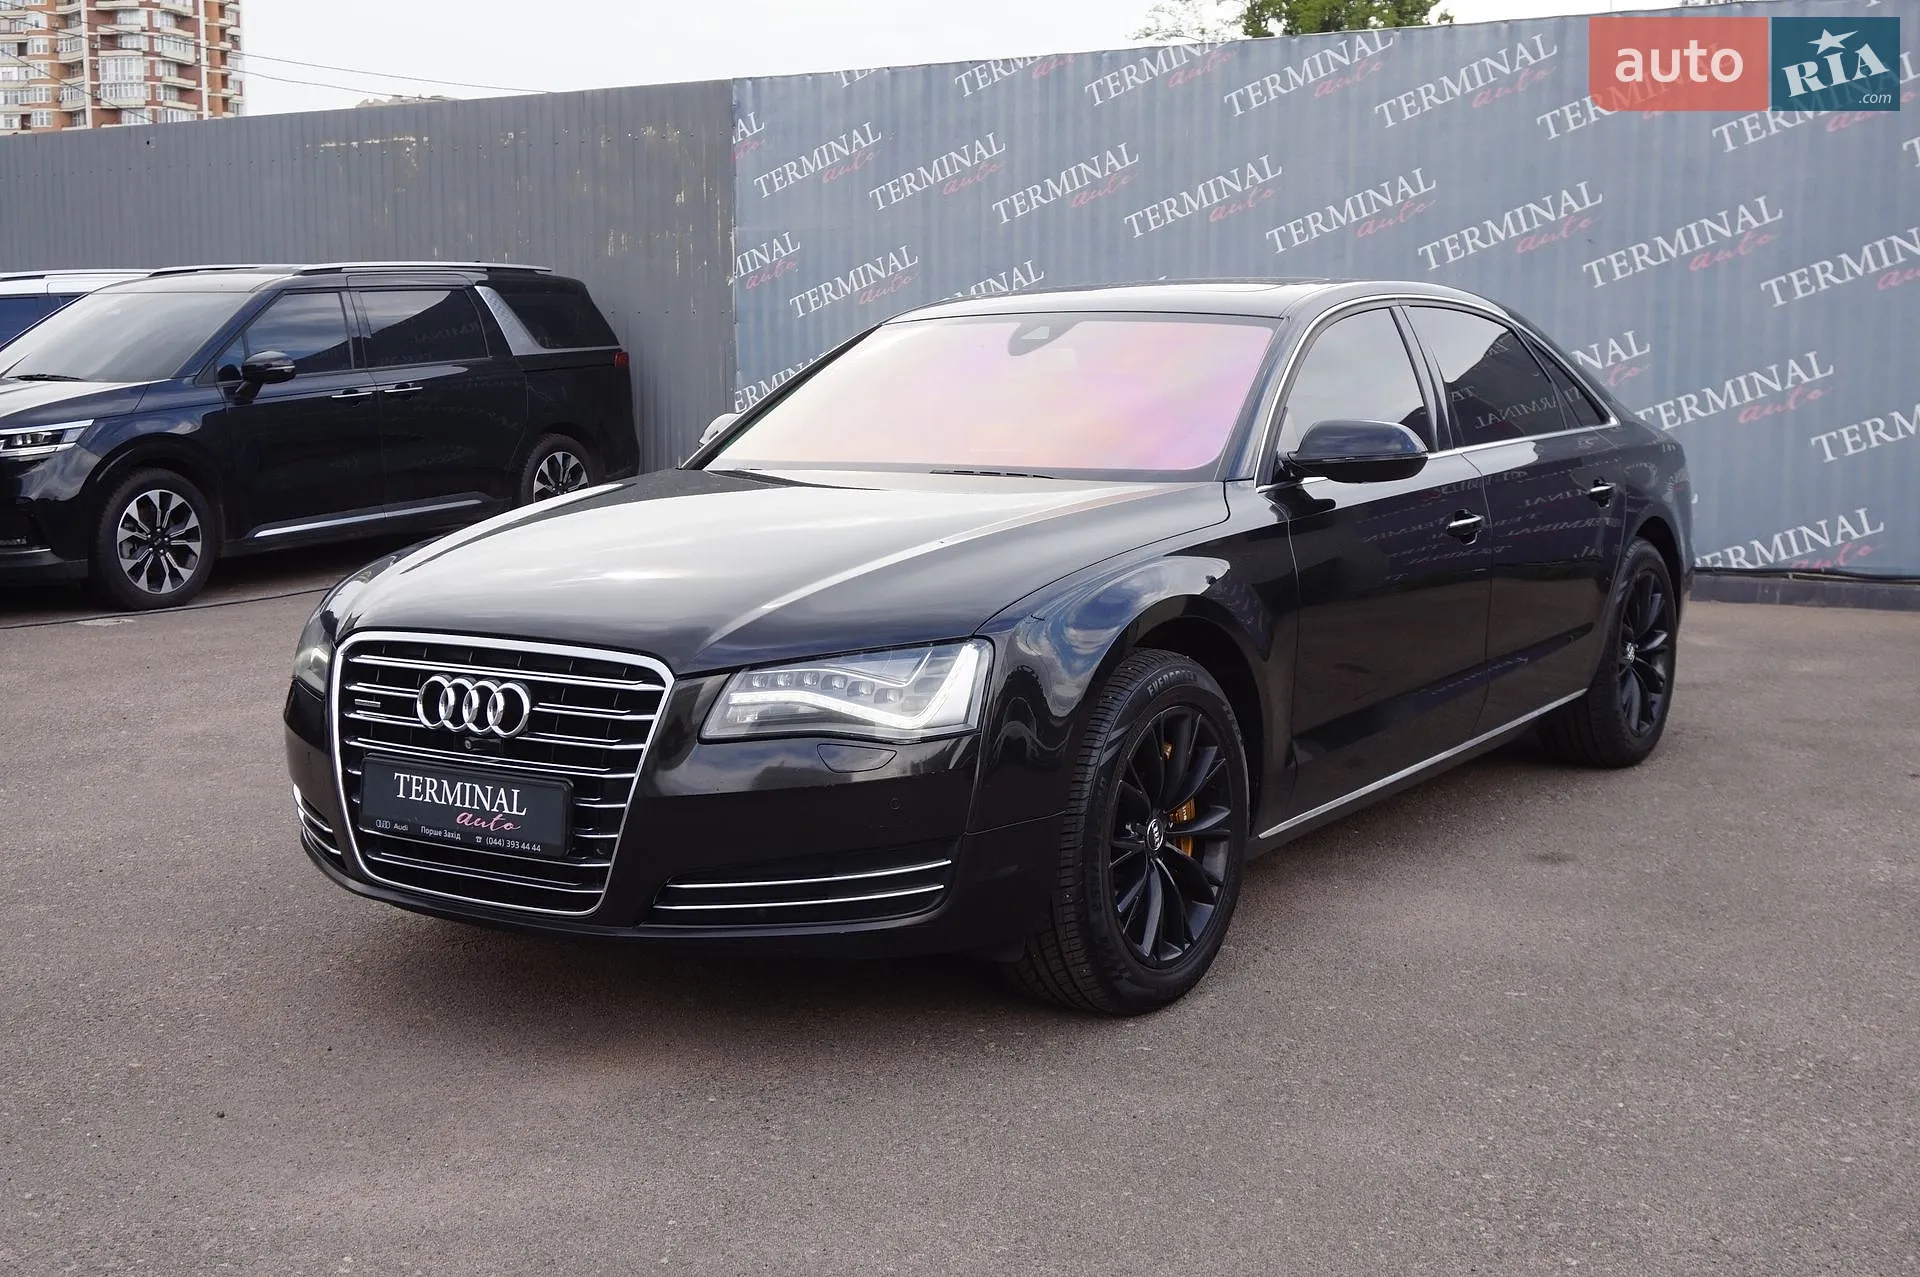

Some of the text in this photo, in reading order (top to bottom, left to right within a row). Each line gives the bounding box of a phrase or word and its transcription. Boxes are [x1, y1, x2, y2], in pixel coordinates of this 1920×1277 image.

[1084, 42, 1229, 107] TERMIN
[1224, 30, 1394, 117] TERMINAL
[1313, 58, 1385, 99] auto
[1374, 33, 1559, 129] TERMINAL
[1471, 65, 1557, 109] auto
[753, 121, 882, 199] TERMINAL
[822, 150, 883, 183] auto
[868, 131, 1006, 211] TERMINAL
[943, 160, 1007, 196] auto
[992, 141, 1140, 225] TERMINAL
[1071, 171, 1139, 209] auto
[1123, 154, 1283, 239] TERMINAL
[1208, 184, 1282, 223] auto
[1265, 167, 1437, 254] TERMINAL
[1356, 199, 1436, 239] auto
[1418, 180, 1603, 271] TERMINAL
[1516, 214, 1601, 255] auto
[1582, 195, 1784, 289] TERMINAL
[1688, 231, 1782, 272] auto
[745, 259, 799, 290] auto
[789, 244, 918, 319] TERMINAL
[858, 272, 919, 305] auto
[1737, 385, 1833, 424] auto
[1695, 507, 1885, 569] ERMINAL
[394, 772, 527, 816] TERMINAL
[393, 823, 409, 832] Audi
[456, 812, 521, 832] auto
[485, 836, 541, 853] (044) 393 44 44
